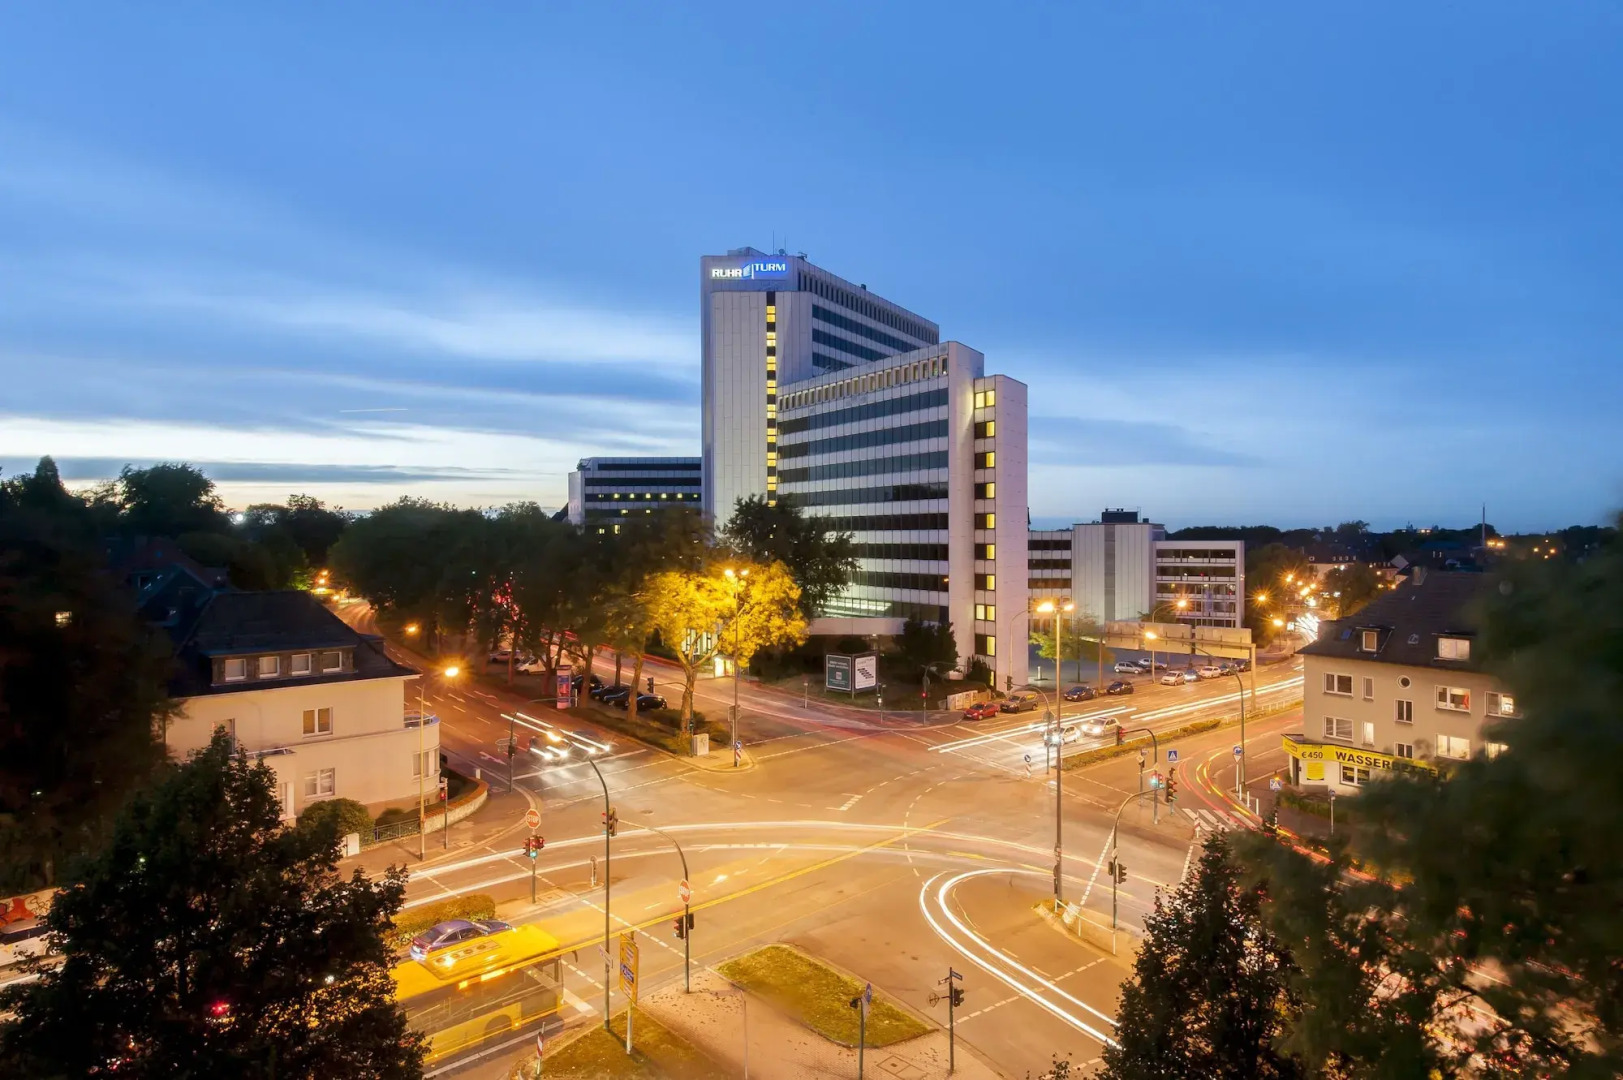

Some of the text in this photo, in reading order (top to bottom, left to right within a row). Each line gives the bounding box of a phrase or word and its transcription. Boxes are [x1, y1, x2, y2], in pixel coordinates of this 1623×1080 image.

[754, 263, 786, 272] TURM
[712, 268, 742, 278] RUHR
[526, 814, 540, 824] STOP
